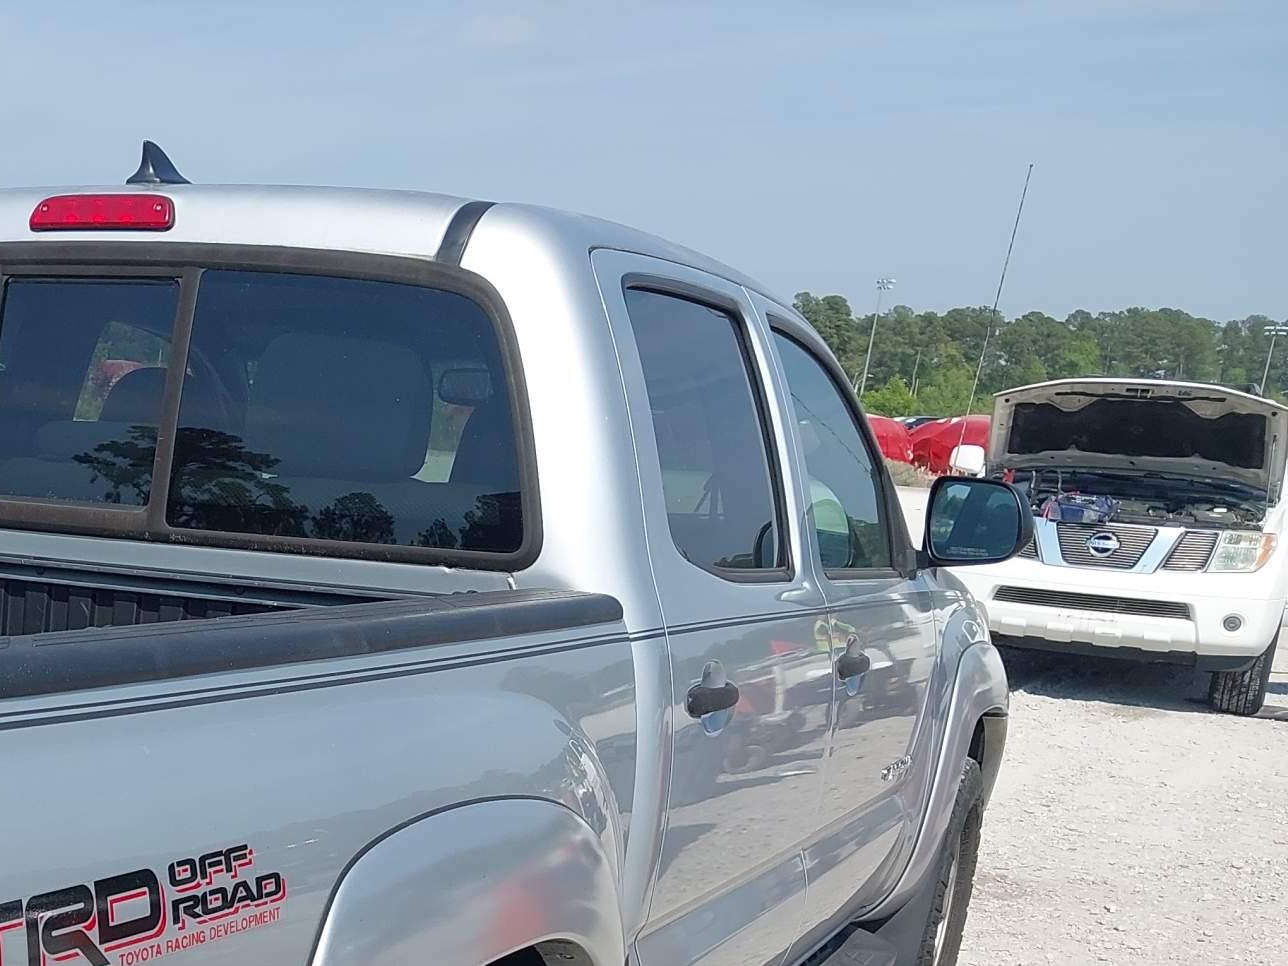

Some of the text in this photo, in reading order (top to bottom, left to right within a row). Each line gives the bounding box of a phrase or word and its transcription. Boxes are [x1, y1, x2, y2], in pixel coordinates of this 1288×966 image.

[167, 843, 254, 893] OFF
[171, 871, 286, 930] ROAD
[166, 930, 207, 956] RACING
[209, 907, 282, 942] DEVELOPMENT
